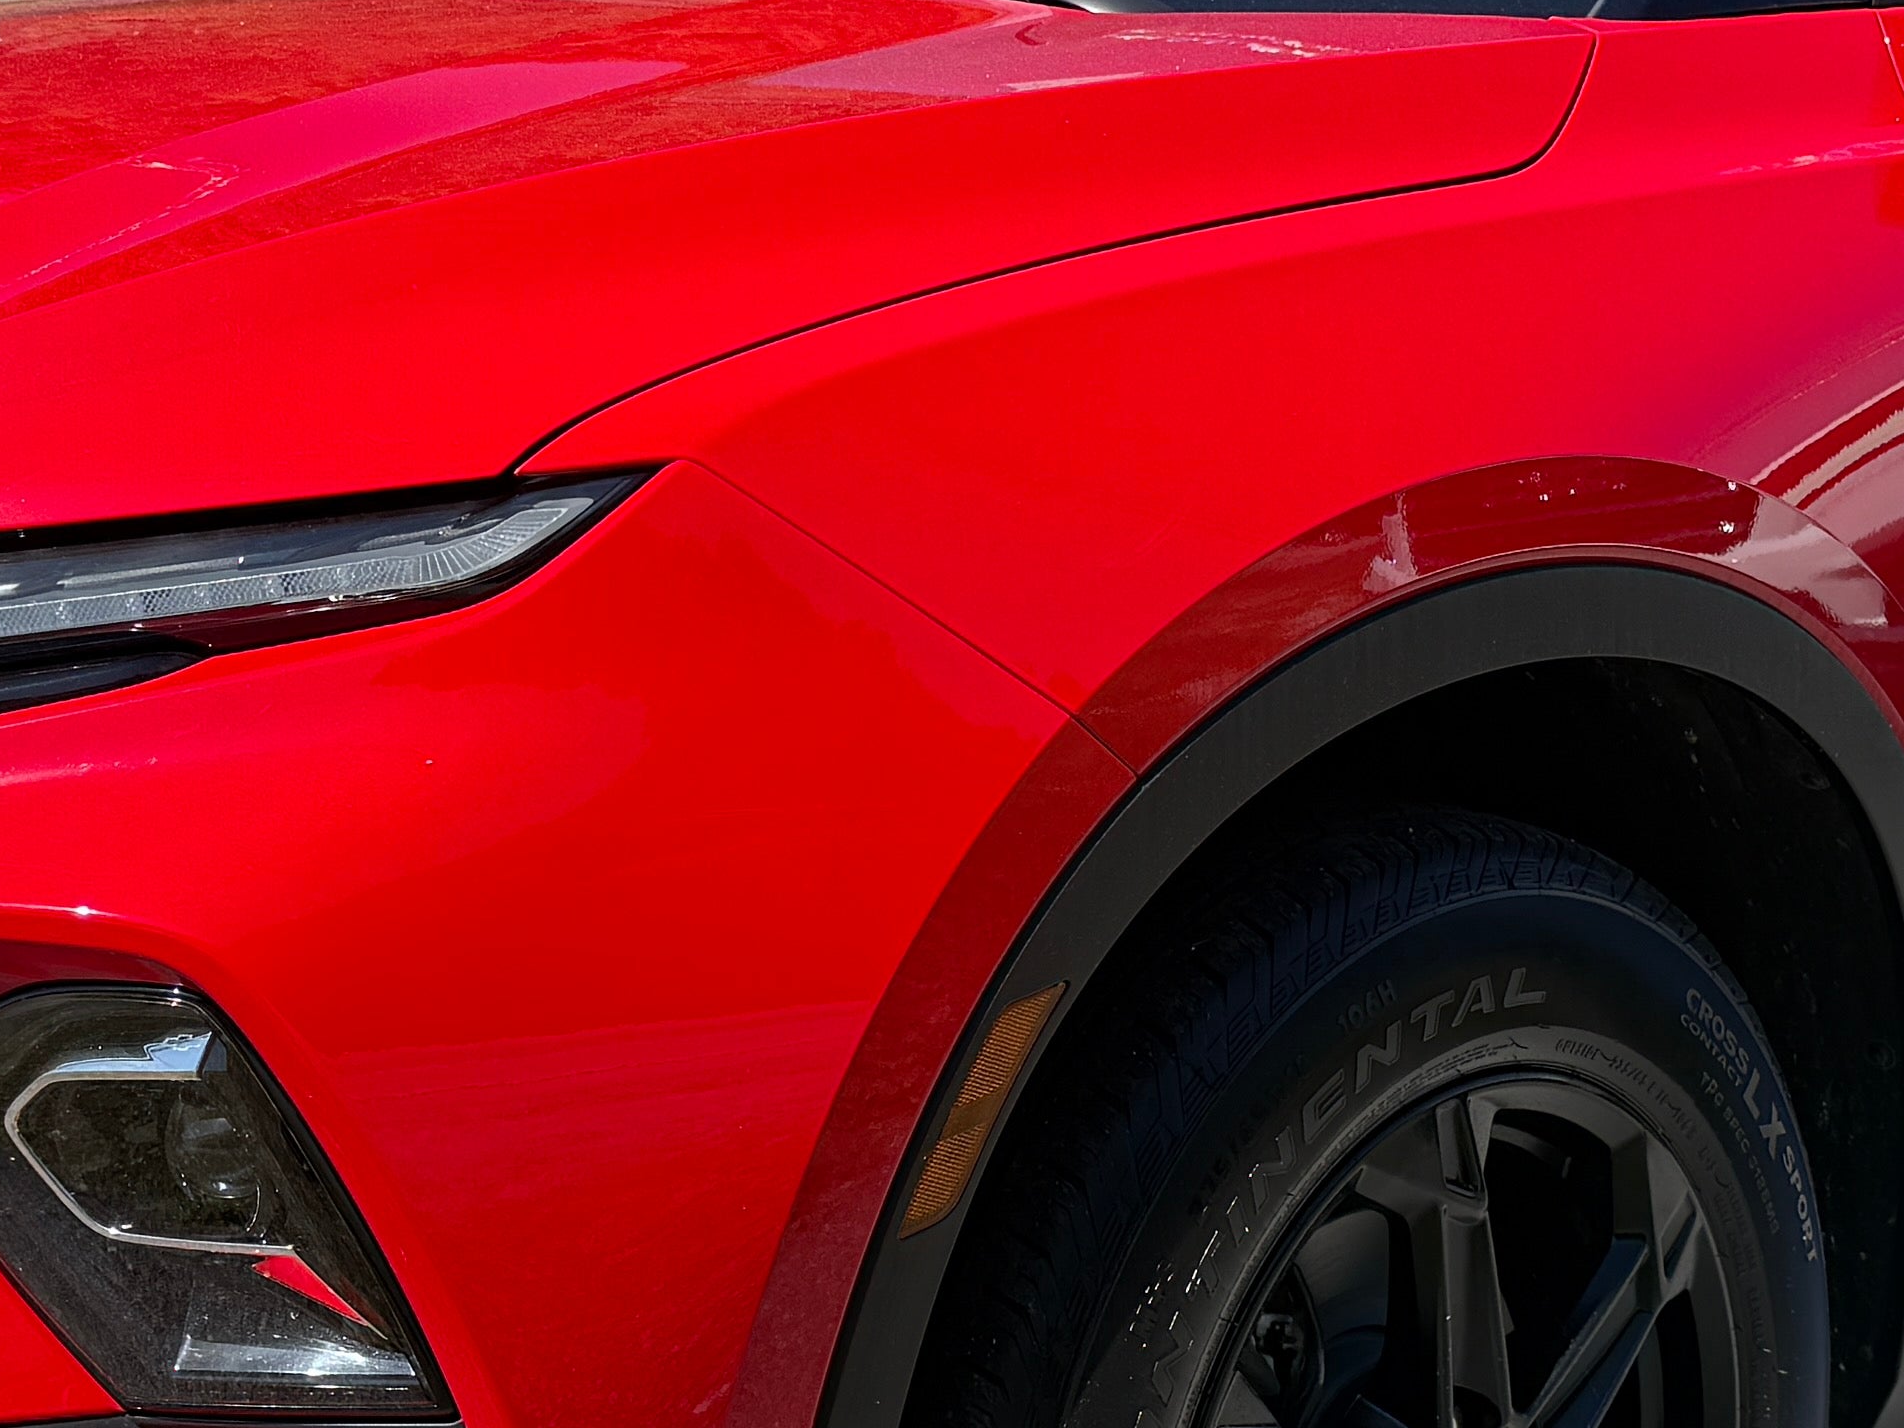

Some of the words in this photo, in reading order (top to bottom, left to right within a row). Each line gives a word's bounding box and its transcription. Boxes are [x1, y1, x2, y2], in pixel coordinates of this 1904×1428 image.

[1680, 1013, 1744, 1087] CONTACT
[1685, 987, 1751, 1075] CROSS
[1782, 1144, 1818, 1263] SPORT
